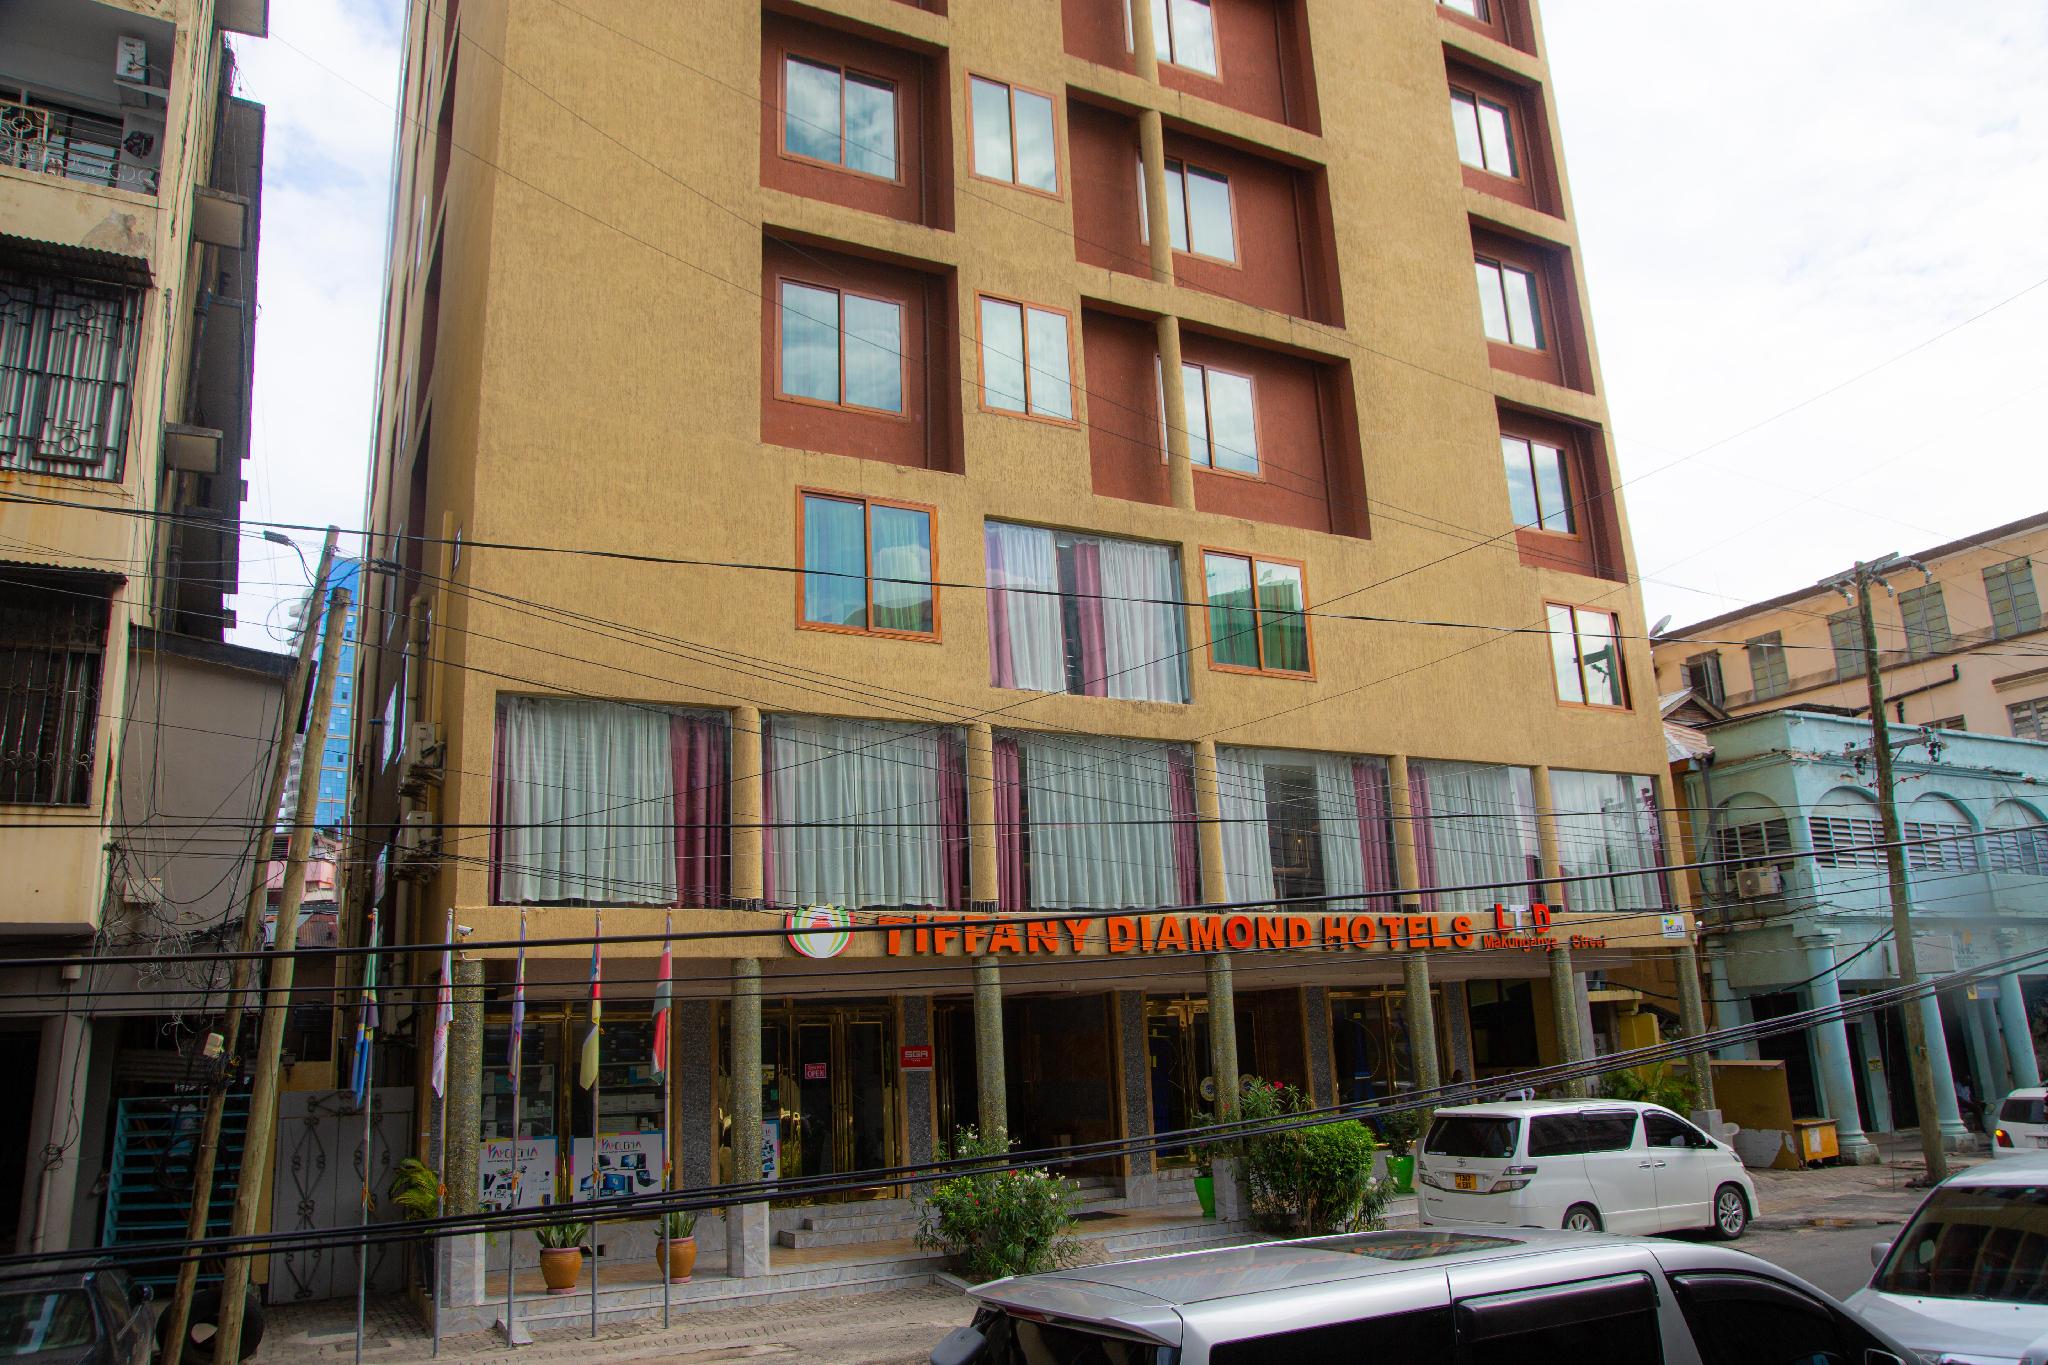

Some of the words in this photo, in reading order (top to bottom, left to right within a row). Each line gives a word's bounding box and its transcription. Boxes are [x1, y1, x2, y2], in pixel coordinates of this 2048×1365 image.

[878, 915, 1092, 955] TIFFANY
[1107, 916, 1313, 953] DIAMOND
[1322, 916, 1475, 950] HOTELS
[1495, 903, 1552, 934] LTD
